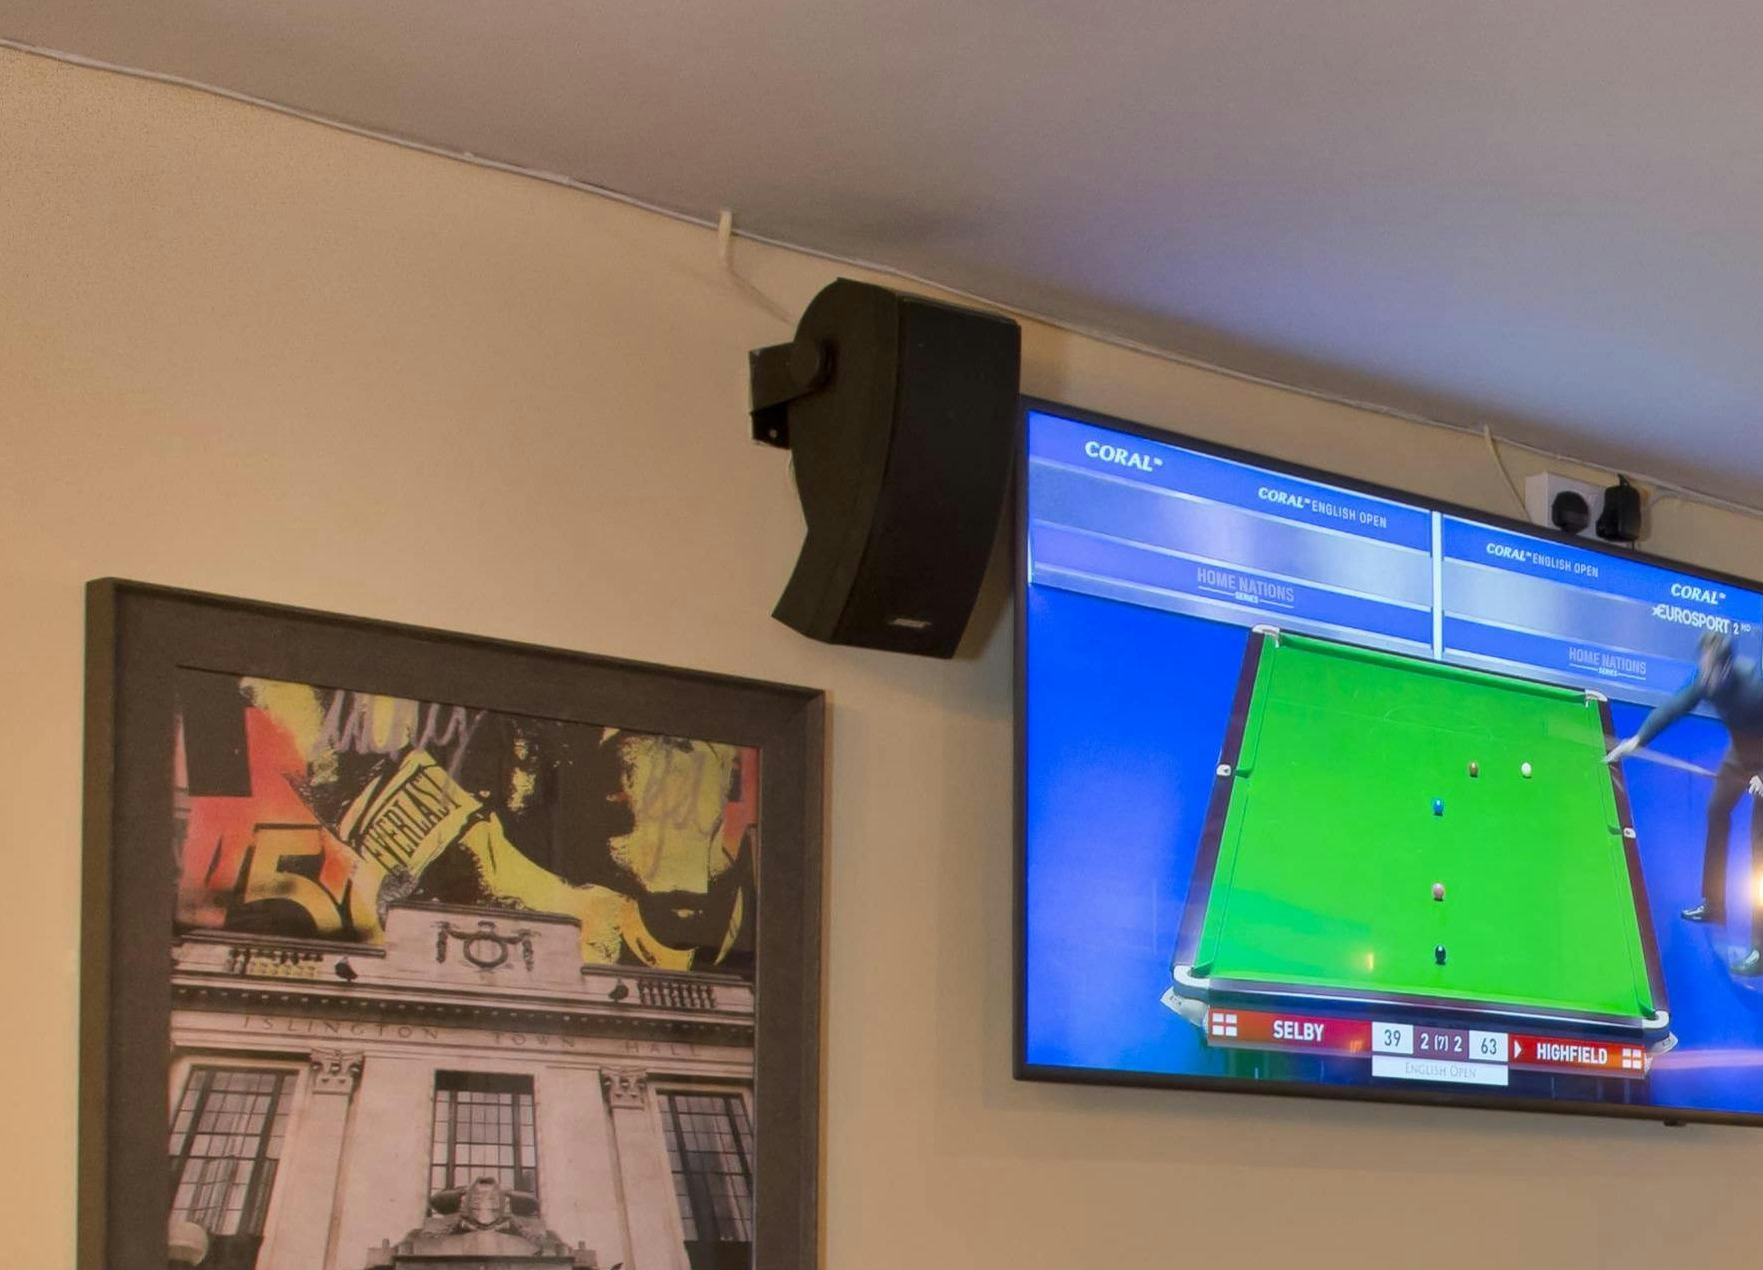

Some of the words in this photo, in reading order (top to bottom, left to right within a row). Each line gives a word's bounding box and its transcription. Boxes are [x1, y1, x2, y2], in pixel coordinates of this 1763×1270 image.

[1085, 441, 1154, 472] CORAL
[1258, 487, 1304, 509] CORAL
[1311, 500, 1356, 521] ENGLISH
[1359, 511, 1387, 528] OPEN
[1486, 543, 1527, 562] CORAL
[1532, 554, 1572, 571] ENGLISH
[1574, 563, 1599, 577] OPEN
[1197, 567, 1237, 590] HOME
[1238, 576, 1294, 602] NATIONS
[1670, 583, 1719, 605] CORAL
[1658, 603, 1730, 634] EUROSPORT
[1733, 622, 1739, 635] 2
[1568, 647, 1600, 667] HOME
[1601, 655, 1646, 675] NATIONS
[361, 770, 462, 879] EVERLAST
[244, 1015, 439, 1041] ISLINGTON
[490, 1031, 576, 1050] TOWN
[625, 1040, 703, 1058] HALL
[1273, 1019, 1325, 1042] SELBY
[1384, 1029, 1402, 1048] 39
[1420, 1033, 1430, 1050] 2
[1454, 1036, 1463, 1053] 2
[1480, 1040, 1498, 1056] 63
[1536, 1043, 1608, 1065] HIGHFIELD
